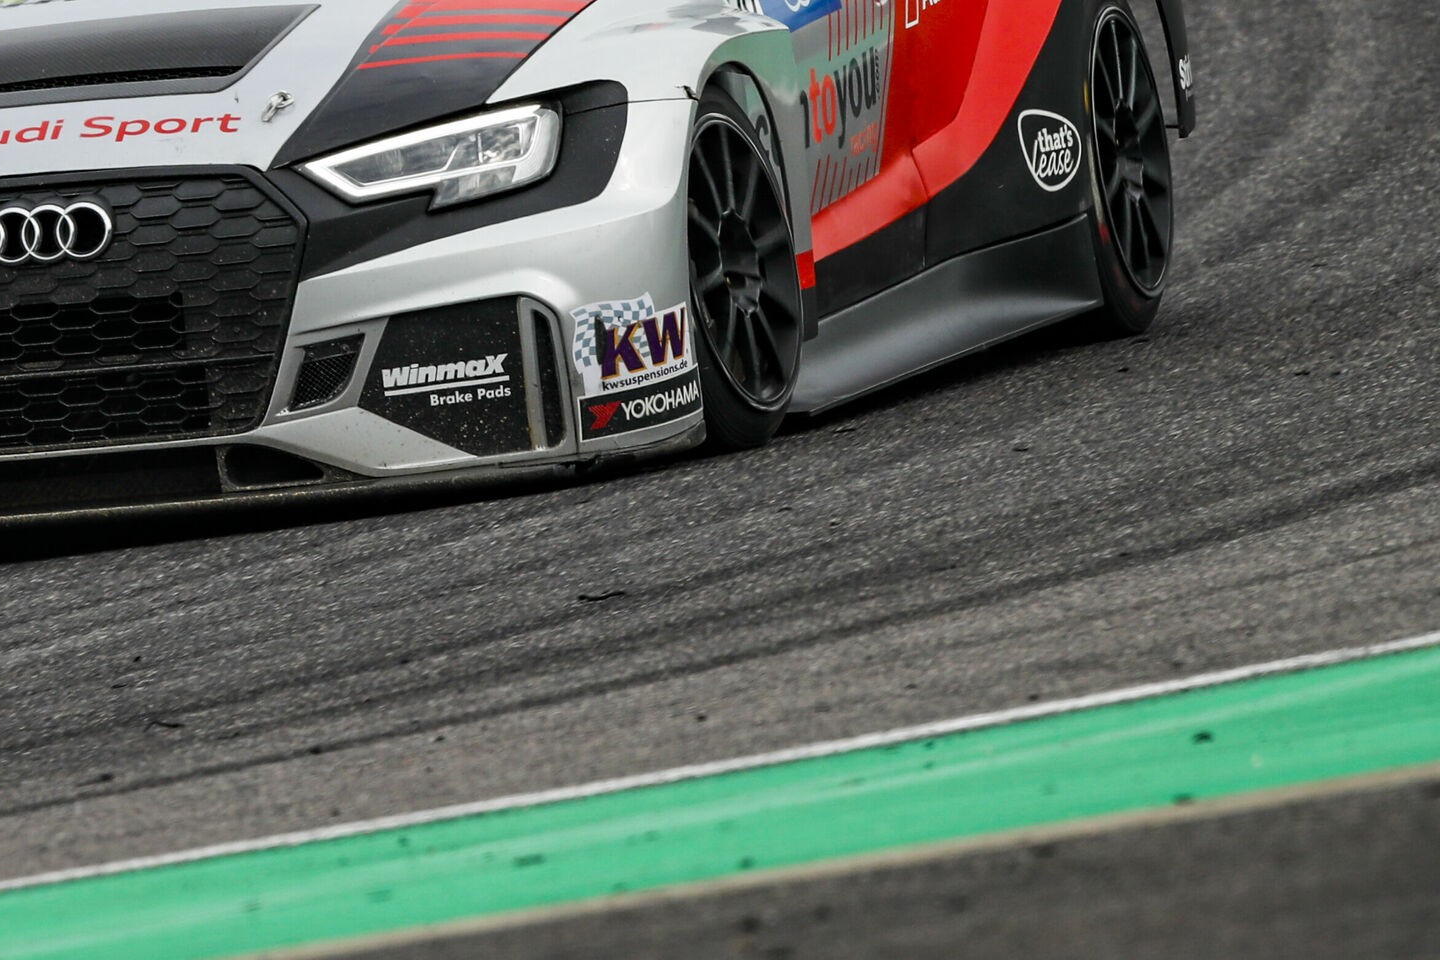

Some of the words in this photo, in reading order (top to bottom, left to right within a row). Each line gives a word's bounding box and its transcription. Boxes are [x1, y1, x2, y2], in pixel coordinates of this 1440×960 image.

[79, 113, 242, 143] Sport
[1037, 123, 1073, 154] that's
[601, 306, 687, 381] KW
[601, 358, 689, 392] kwsuspensions.de
[429, 393, 473, 407] Brake
[477, 385, 511, 403] Pads
[621, 380, 700, 421] YOKOHAMA
